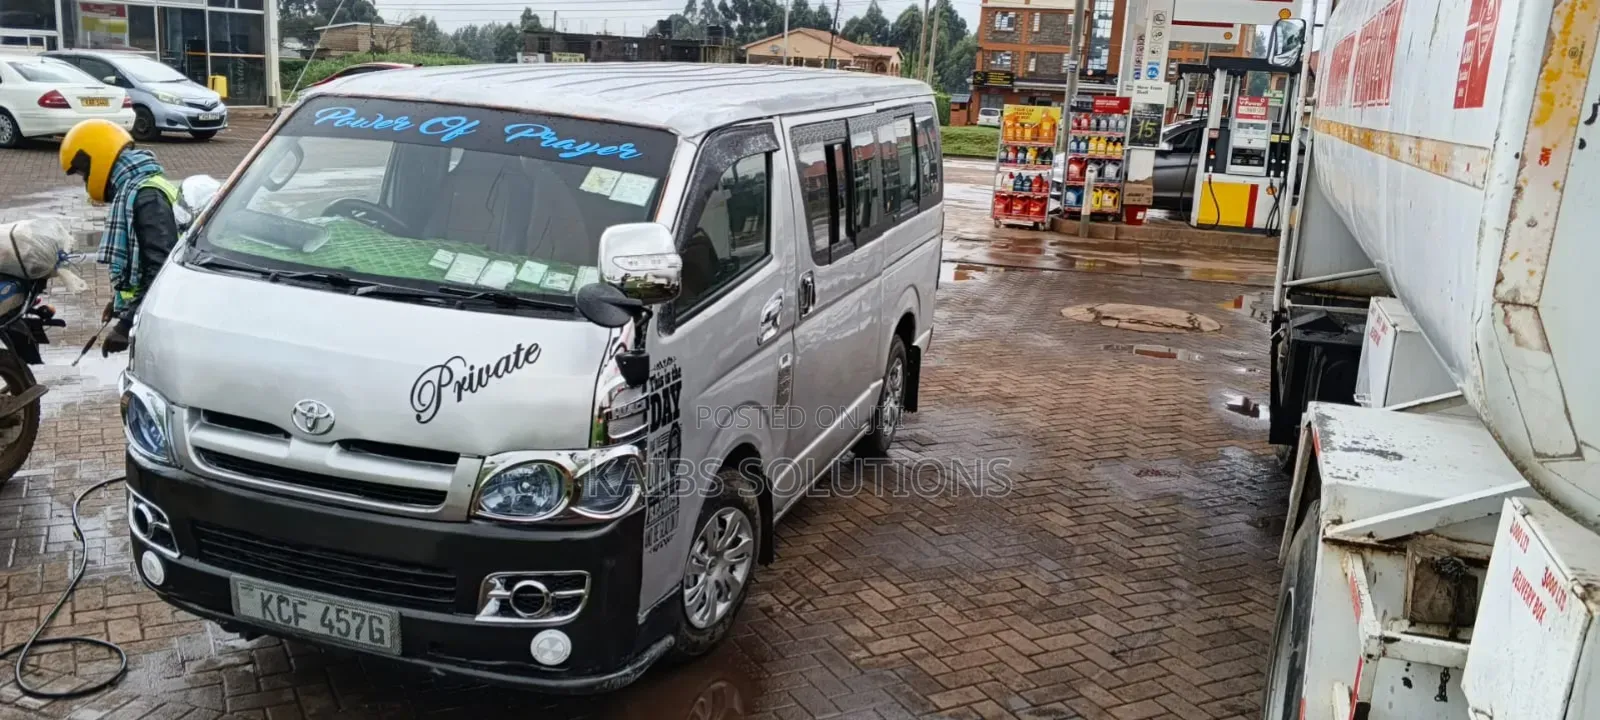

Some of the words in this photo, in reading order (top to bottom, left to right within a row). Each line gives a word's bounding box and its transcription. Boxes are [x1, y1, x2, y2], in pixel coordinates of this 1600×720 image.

[314, 107, 415, 131] Power
[419, 115, 480, 142] Of
[504, 123, 643, 159] Prayer
[1539, 147, 1552, 167] 3M
[410, 342, 541, 424] Private
[650, 380, 682, 433] DAY
[260, 592, 307, 626] KCF
[320, 605, 385, 645] 457G
[1512, 566, 1537, 608] DELIVERY
[1532, 596, 1546, 625] BOX
